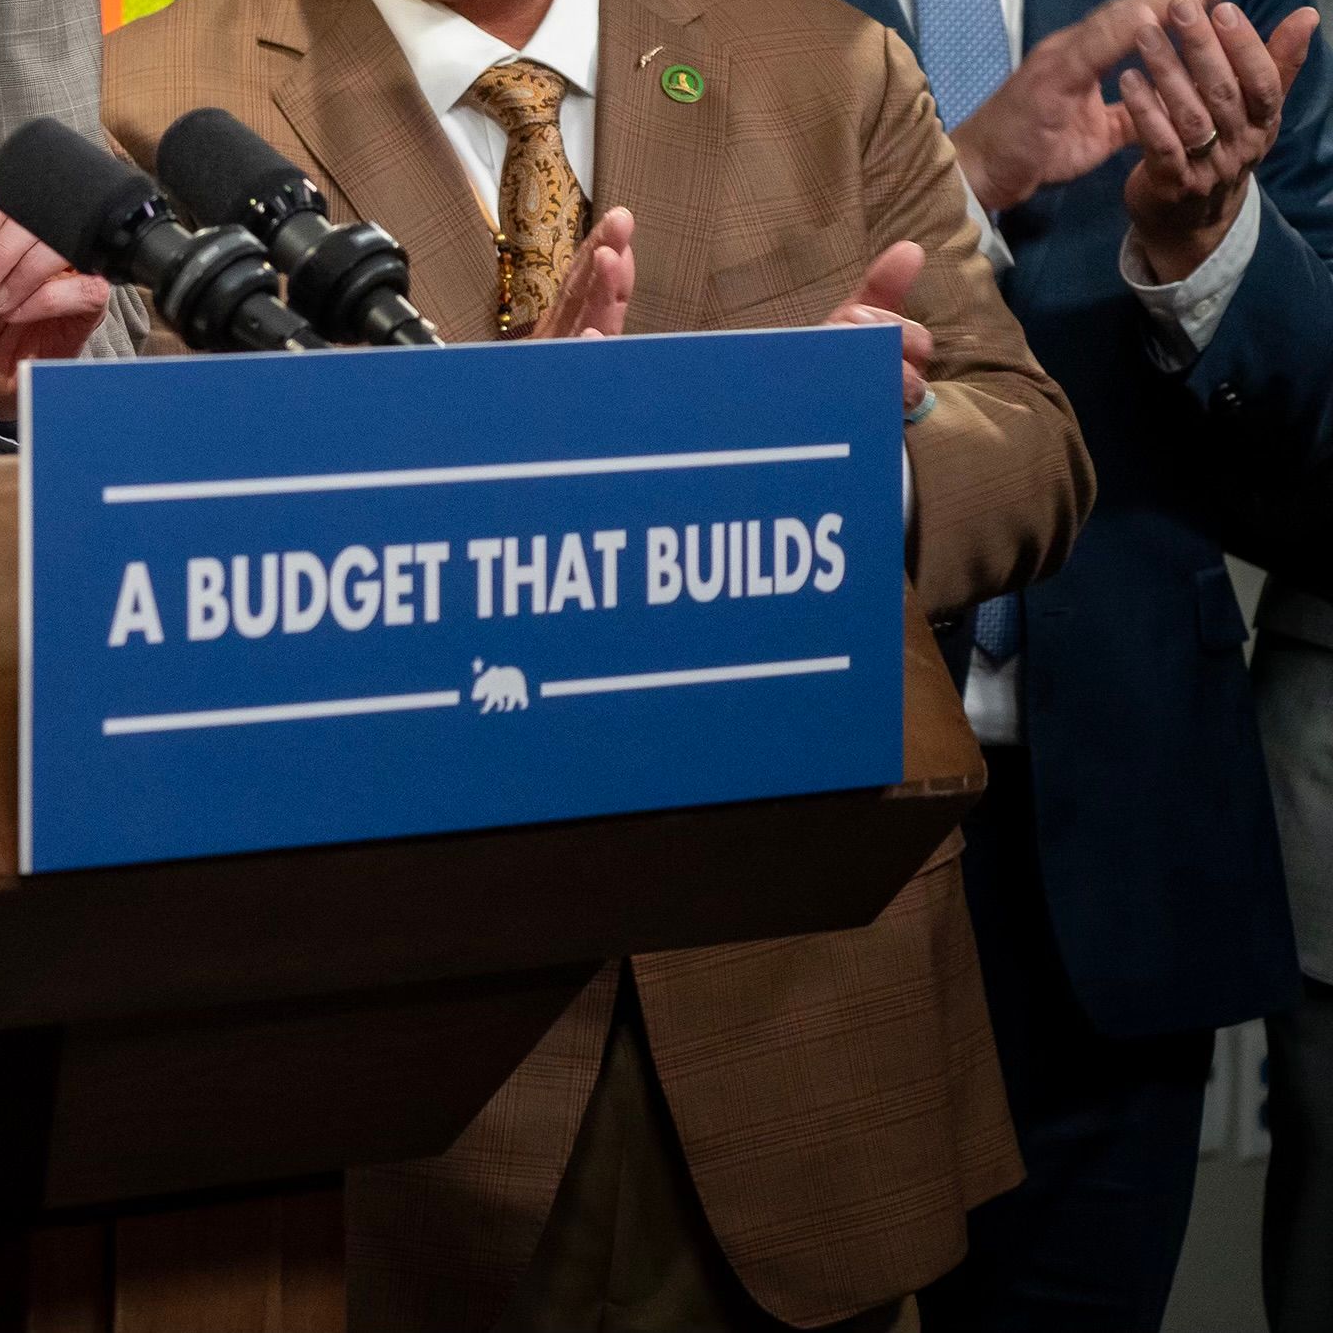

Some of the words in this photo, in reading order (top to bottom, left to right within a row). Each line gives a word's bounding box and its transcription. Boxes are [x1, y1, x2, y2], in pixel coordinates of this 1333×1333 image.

[108, 561, 164, 647] A
[187, 542, 450, 641] BUDGET
[468, 529, 627, 618] THAT
[647, 513, 846, 605] BUILDS
